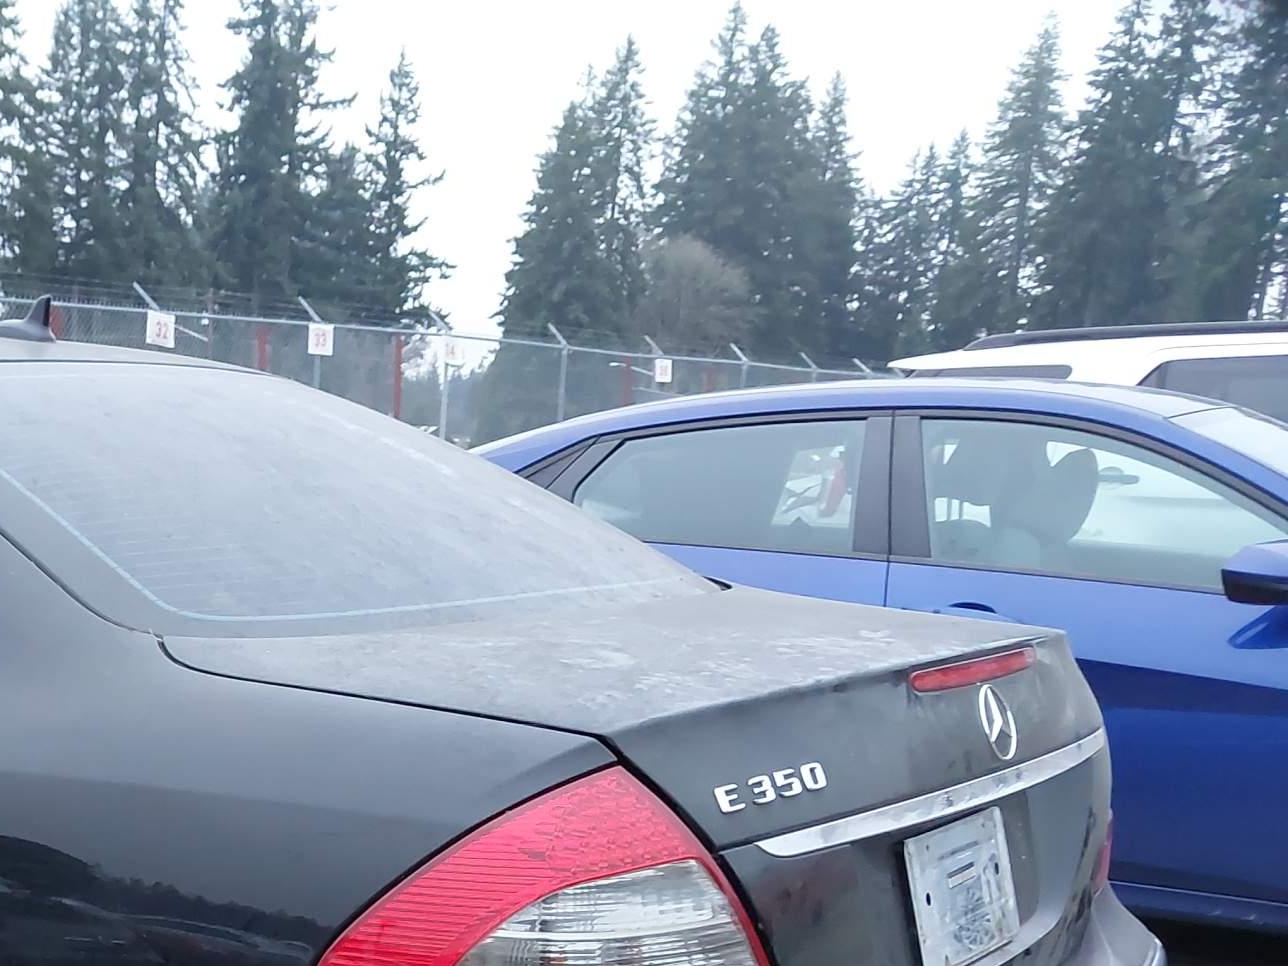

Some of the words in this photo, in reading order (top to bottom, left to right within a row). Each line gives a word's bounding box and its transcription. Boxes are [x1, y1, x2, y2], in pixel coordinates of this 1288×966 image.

[155, 320, 169, 340] 32
[714, 783, 746, 814] E
[747, 761, 827, 804] 350
